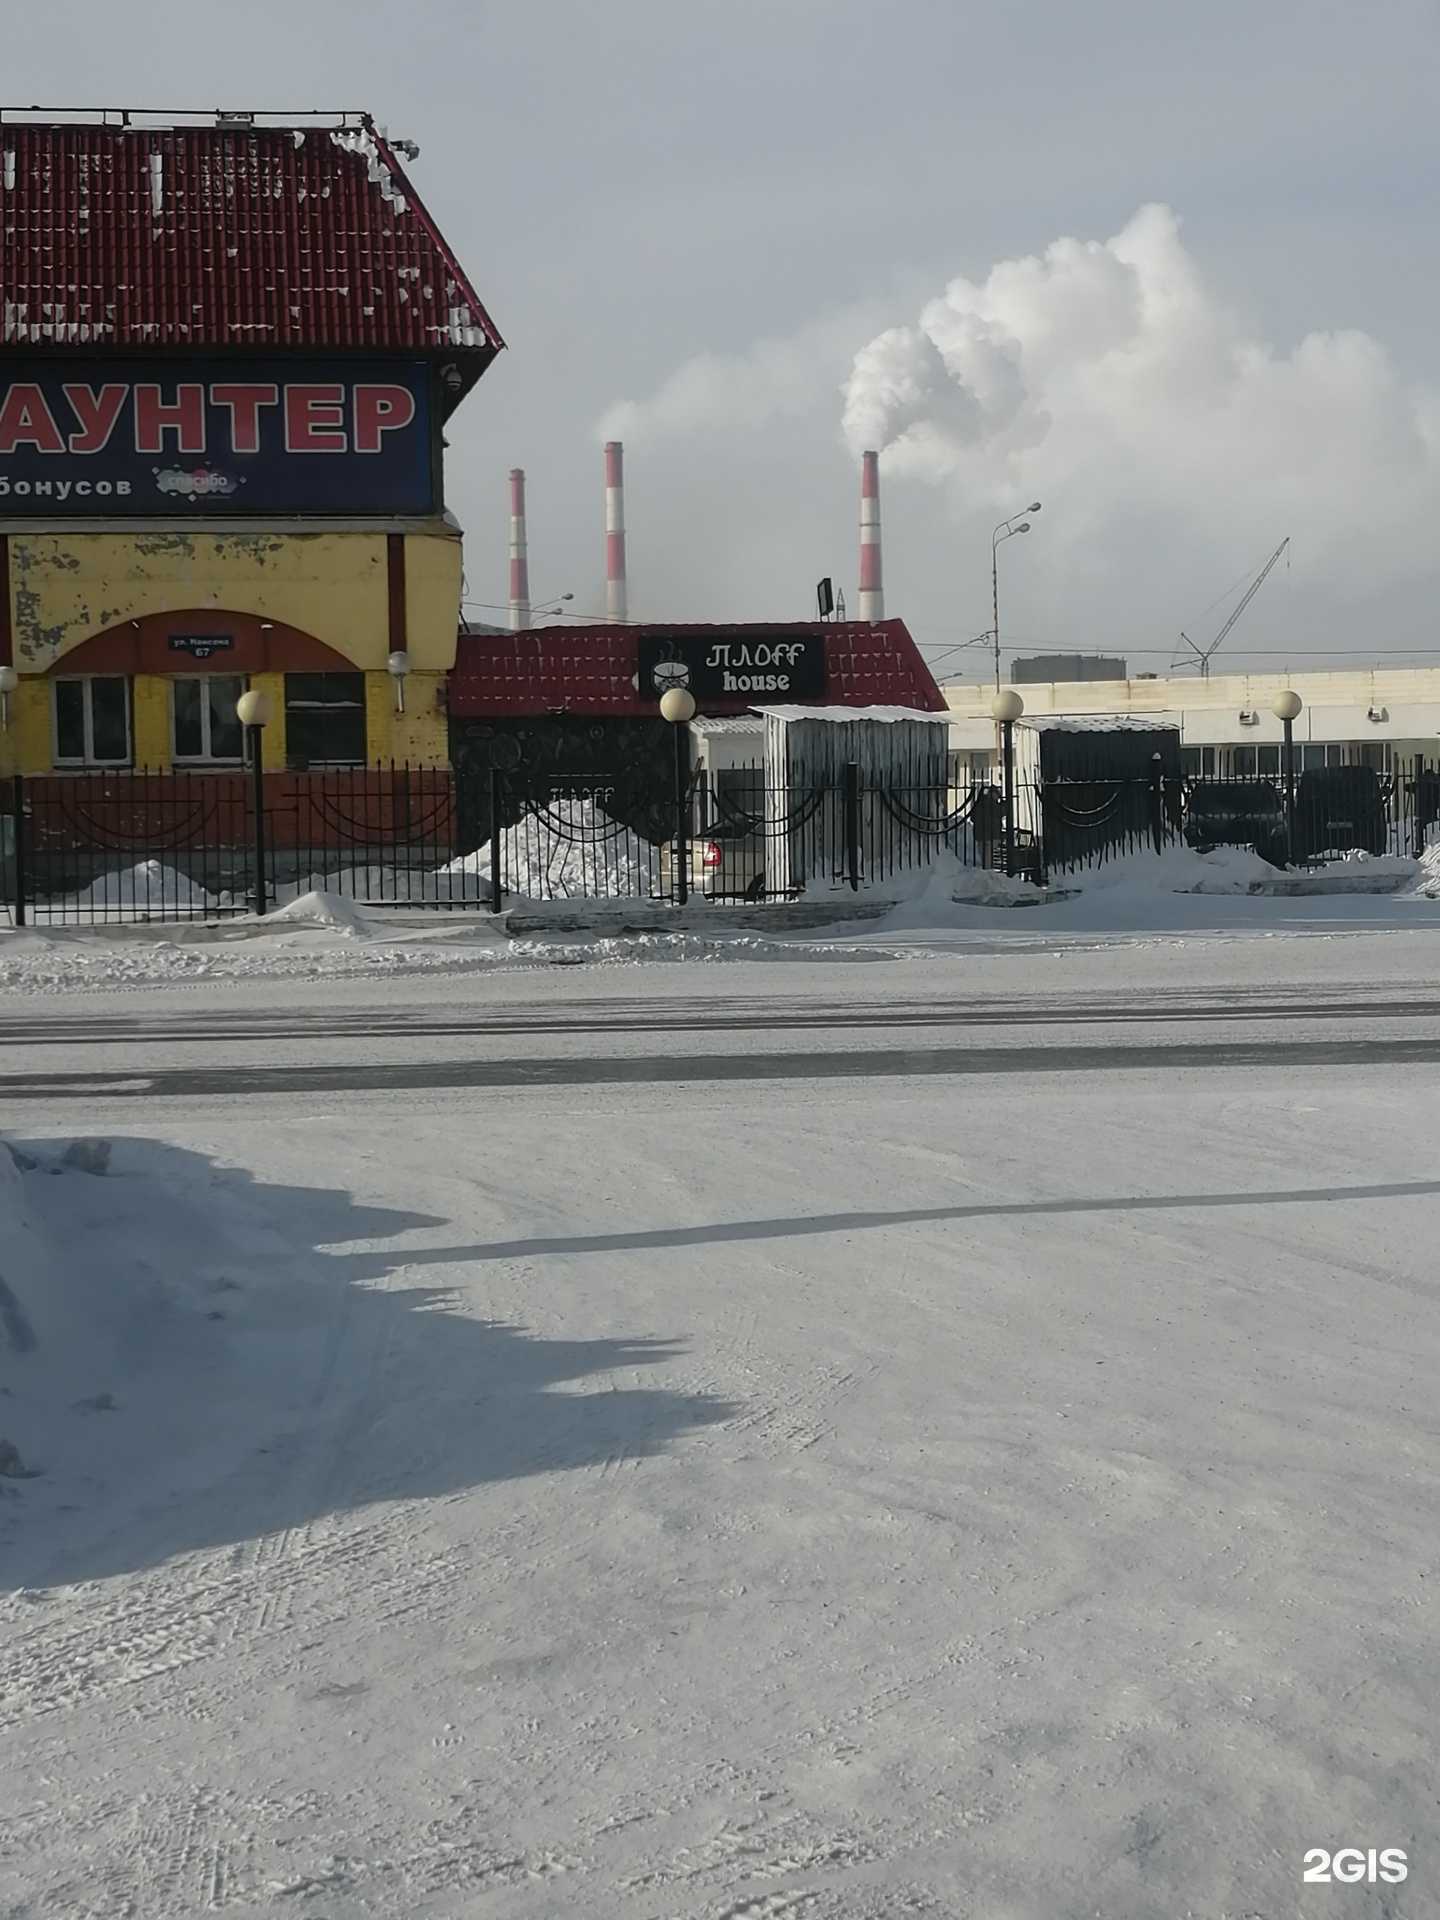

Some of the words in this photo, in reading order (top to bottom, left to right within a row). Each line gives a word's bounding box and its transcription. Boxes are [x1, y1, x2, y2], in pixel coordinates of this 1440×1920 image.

[0, 383, 415, 453] АУНТЕР
[0, 476, 132, 500] бонусов
[723, 670, 790, 691] house
